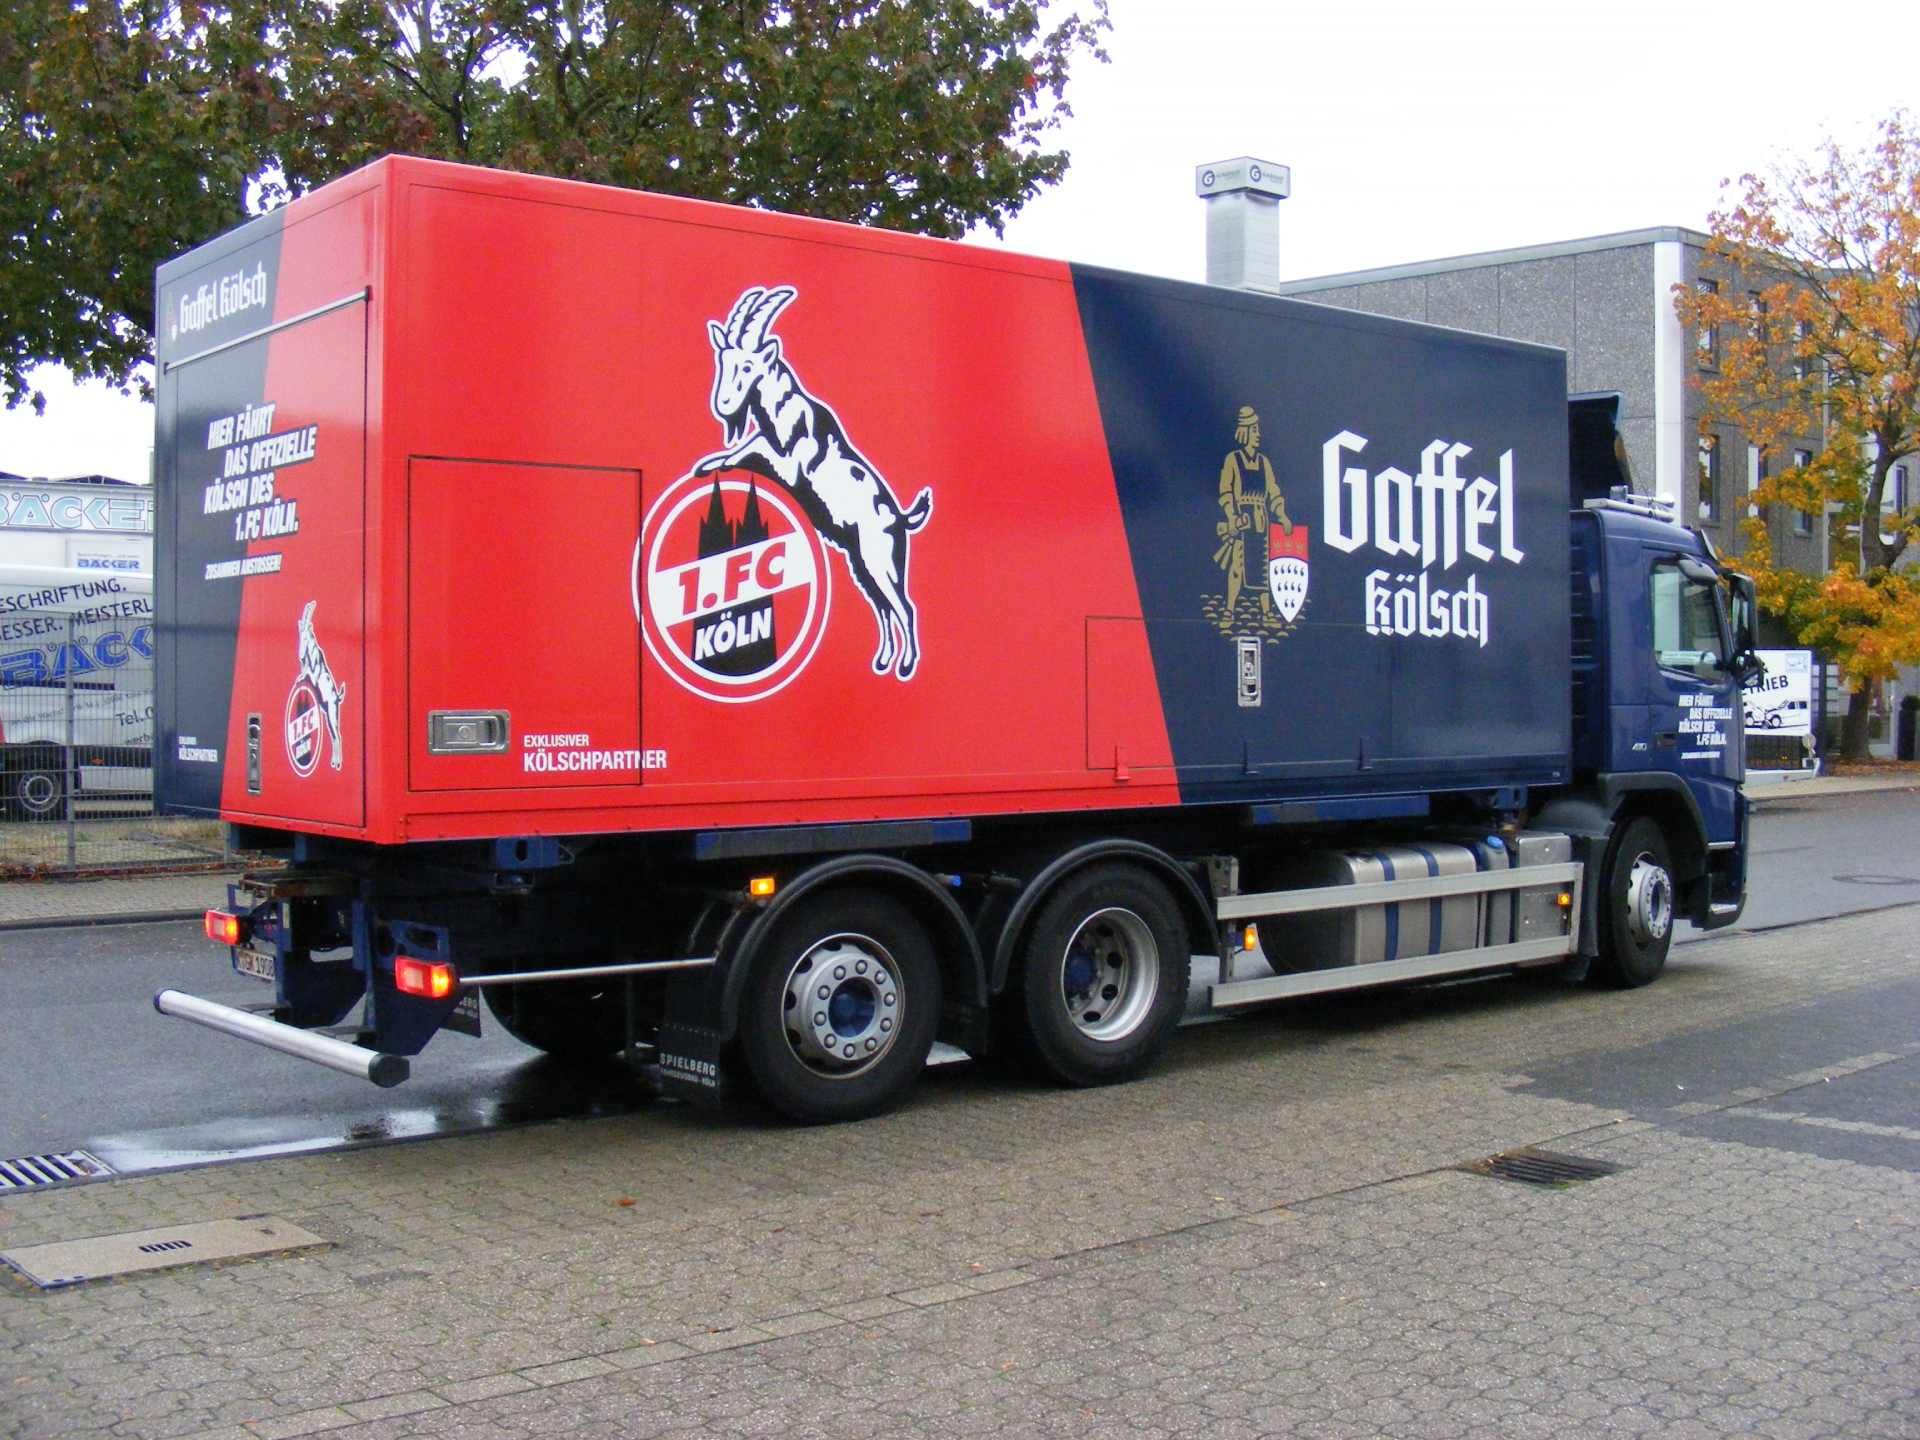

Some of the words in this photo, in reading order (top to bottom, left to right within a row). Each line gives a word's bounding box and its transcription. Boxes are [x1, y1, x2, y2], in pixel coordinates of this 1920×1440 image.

[181, 280, 218, 333] Gaffel
[220, 260, 267, 318] Kölsch
[208, 416, 234, 450] HIER
[236, 404, 276, 442] FÄHRT
[224, 445, 249, 478] DAS
[250, 426, 318, 472] OFFIZIELLE
[0, 492, 153, 530] ÄCKE
[204, 478, 249, 514] KÖLSCH
[249, 472, 275, 504] DES
[1323, 430, 1524, 571] Gaffel
[262, 497, 299, 536] KÖLN.
[0, 618, 63, 641] ESSER.
[1365, 569, 1488, 648] Kölsch
[695, 607, 772, 661] KÖLN
[523, 734, 589, 748] EXKLUSIVER
[523, 749, 667, 772] KÖLSCHPARTNER
[660, 1052, 716, 1077] SPIELBERG
